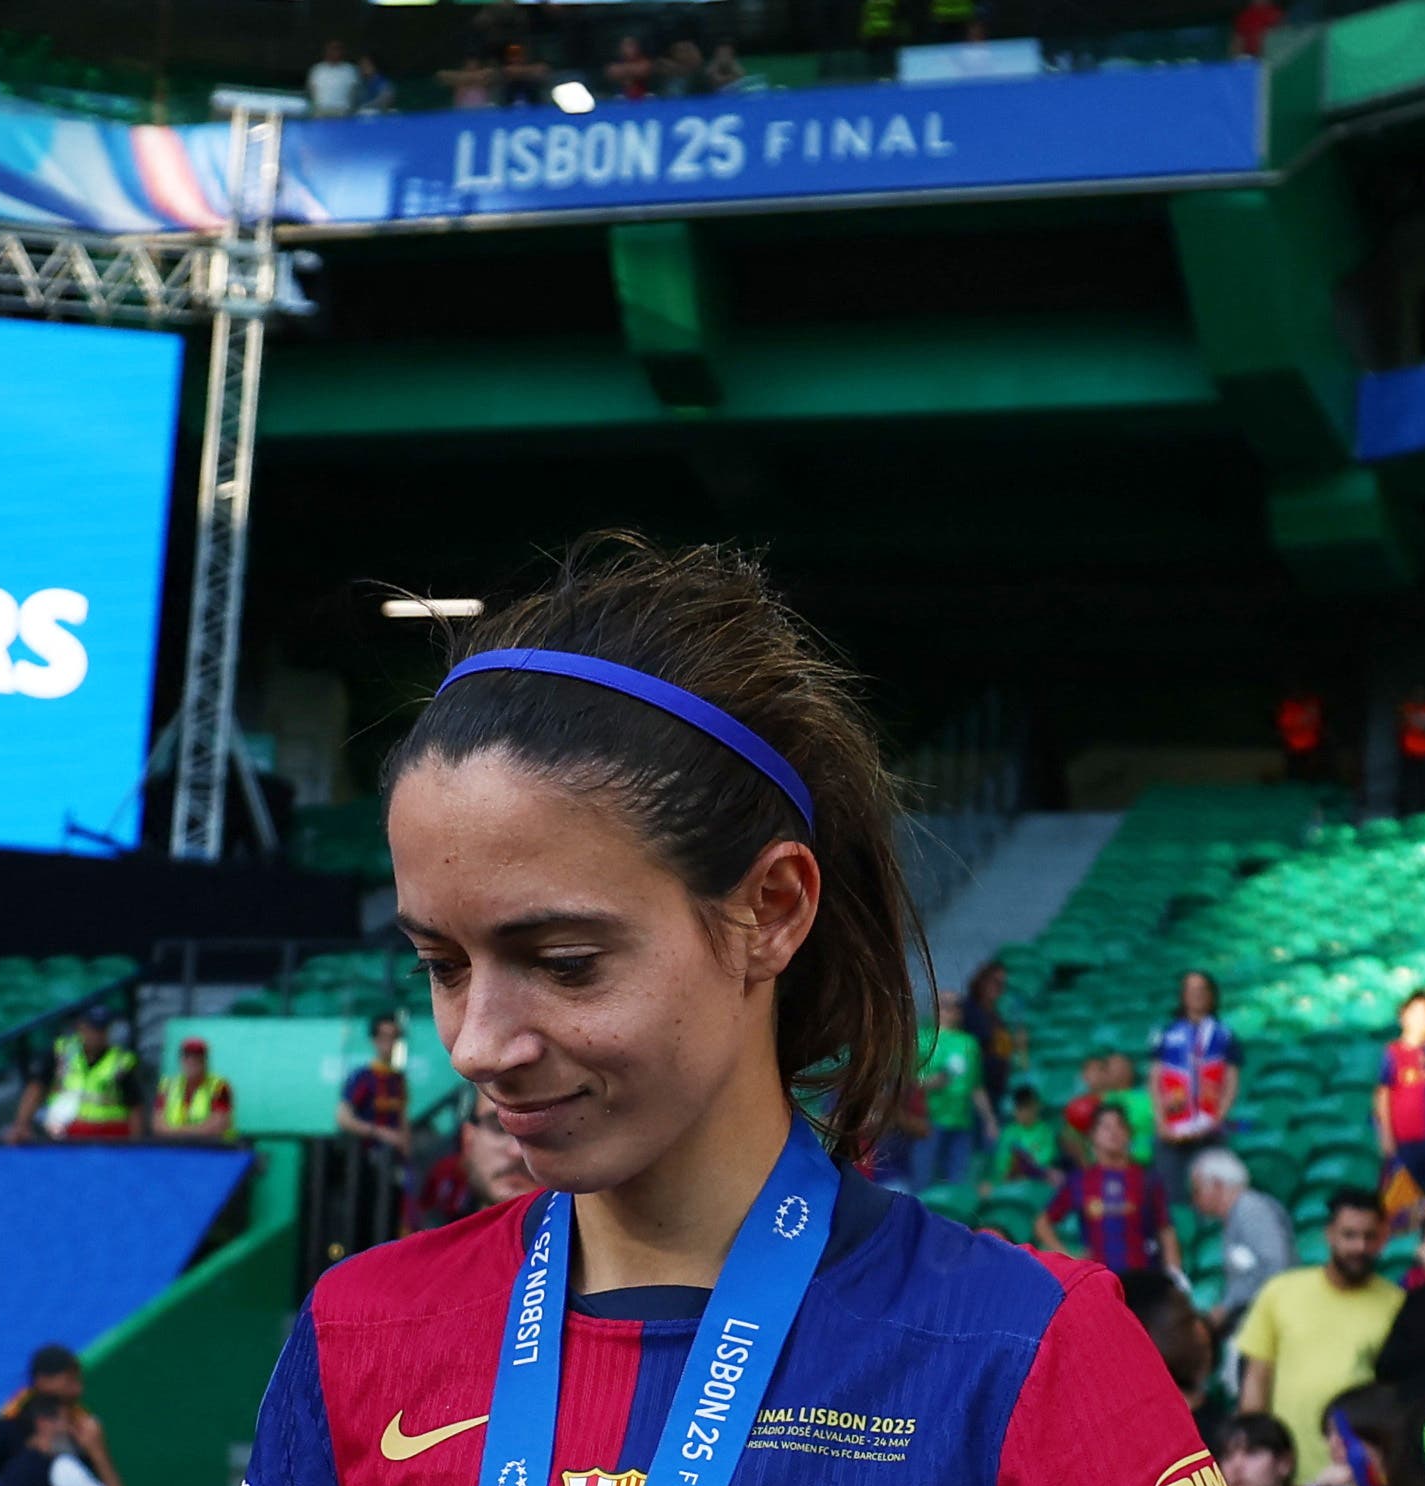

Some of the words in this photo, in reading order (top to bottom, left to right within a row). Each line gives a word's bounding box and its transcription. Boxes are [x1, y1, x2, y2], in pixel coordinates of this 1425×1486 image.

[453, 119, 662, 190] LISBON
[669, 114, 746, 181] 25
[764, 111, 954, 163] FINAL
[513, 1268, 548, 1366] LISBON
[531, 1231, 551, 1267] 25
[695, 1318, 760, 1422] LISBON
[752, 1426, 785, 1436] STÁDIO
[786, 1425, 811, 1437] JOSÉ
[813, 1429, 865, 1445] ALVALADE
[873, 1437, 887, 1447] 24
[888, 1438, 911, 1447] MAY
[757, 1407, 794, 1423] INAL
[799, 1407, 866, 1431] LISBON
[870, 1417, 916, 1434] 2025
[681, 1421, 720, 1461] 25
[747, 1440, 779, 1449] RSENAL
[781, 1441, 817, 1453] WOMEN
[818, 1445, 830, 1456] FC
[841, 1449, 852, 1459] FC
[853, 1451, 906, 1462] BARCELONA
